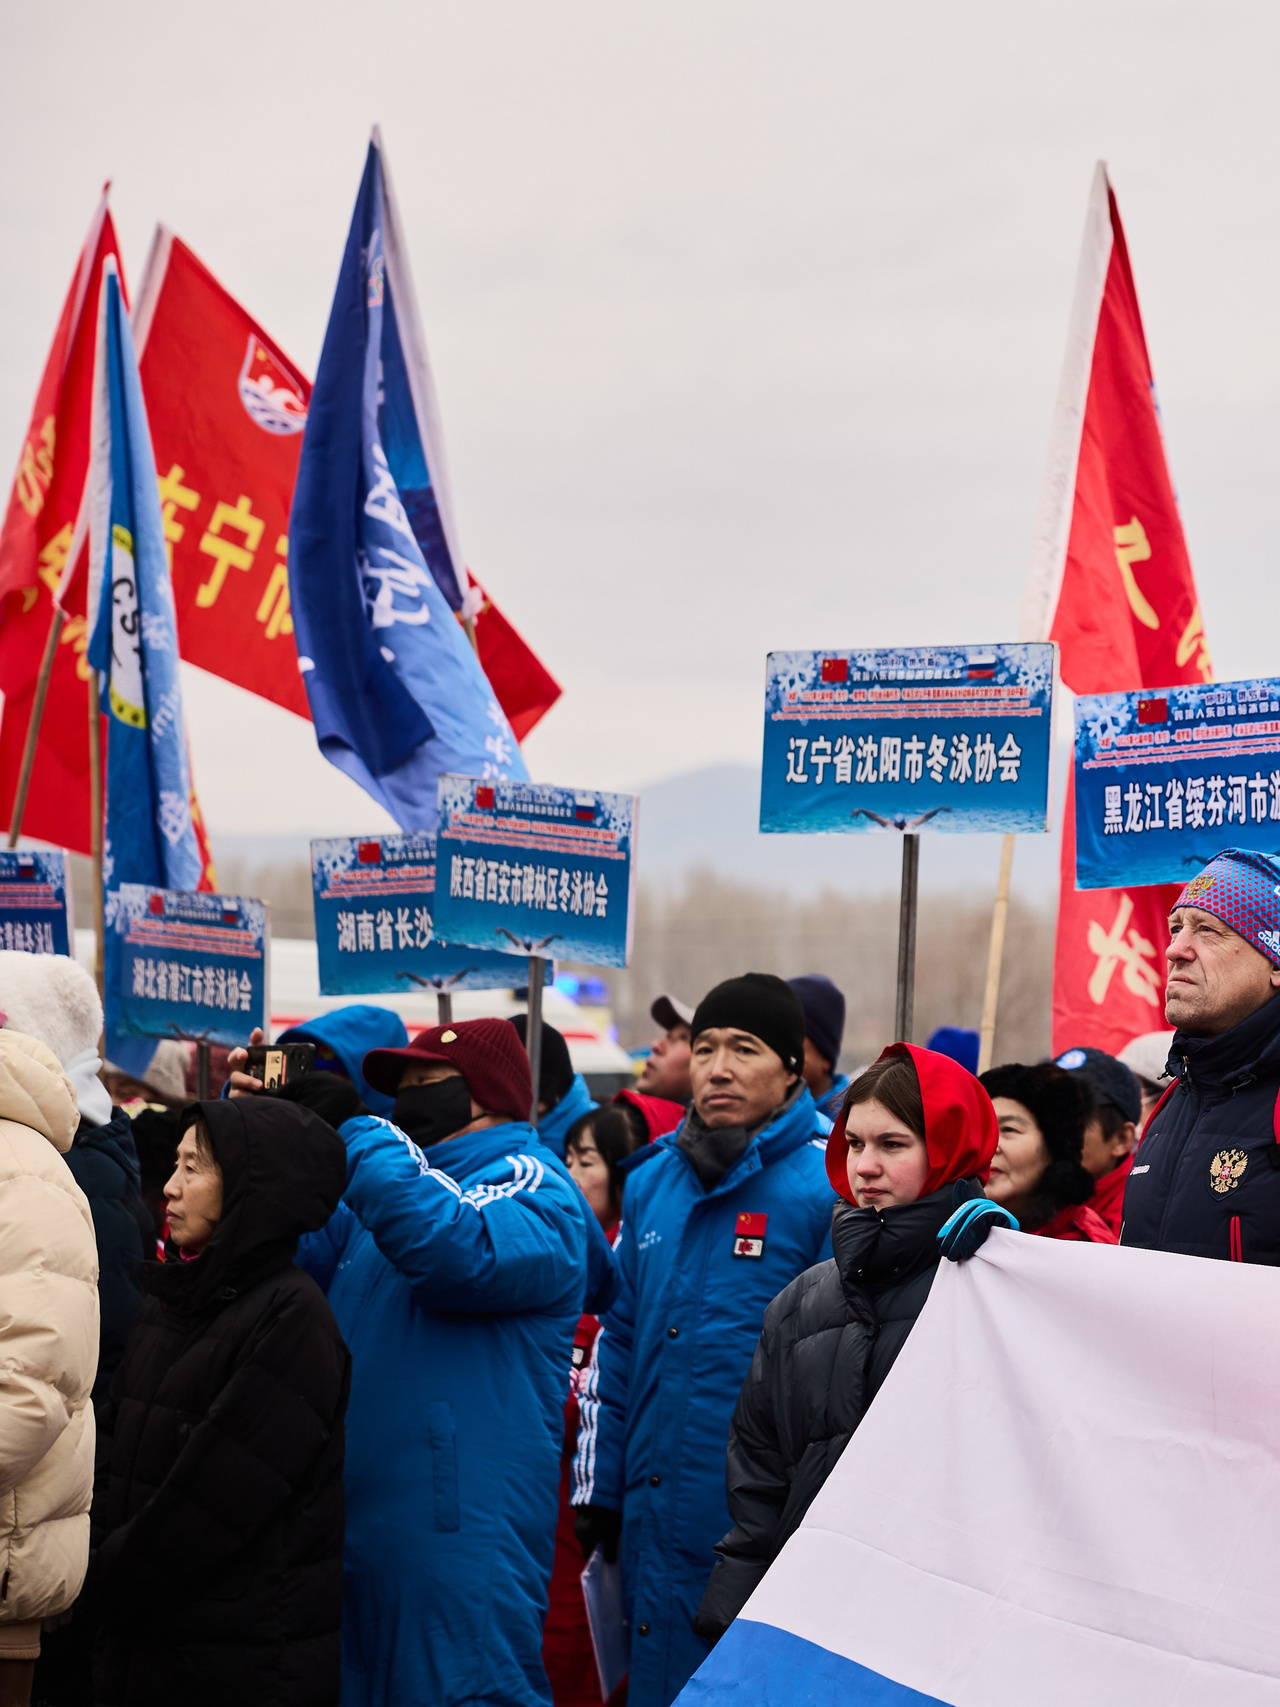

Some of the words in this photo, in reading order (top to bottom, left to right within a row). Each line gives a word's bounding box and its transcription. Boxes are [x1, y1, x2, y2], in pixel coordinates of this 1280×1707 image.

[786, 732, 1022, 784] 辽宁省沈阳市冬泳协会
[450, 854, 609, 918] 陕西省西安市碑林区冬泳协会
[336, 905, 434, 953] 湖南省长沙
